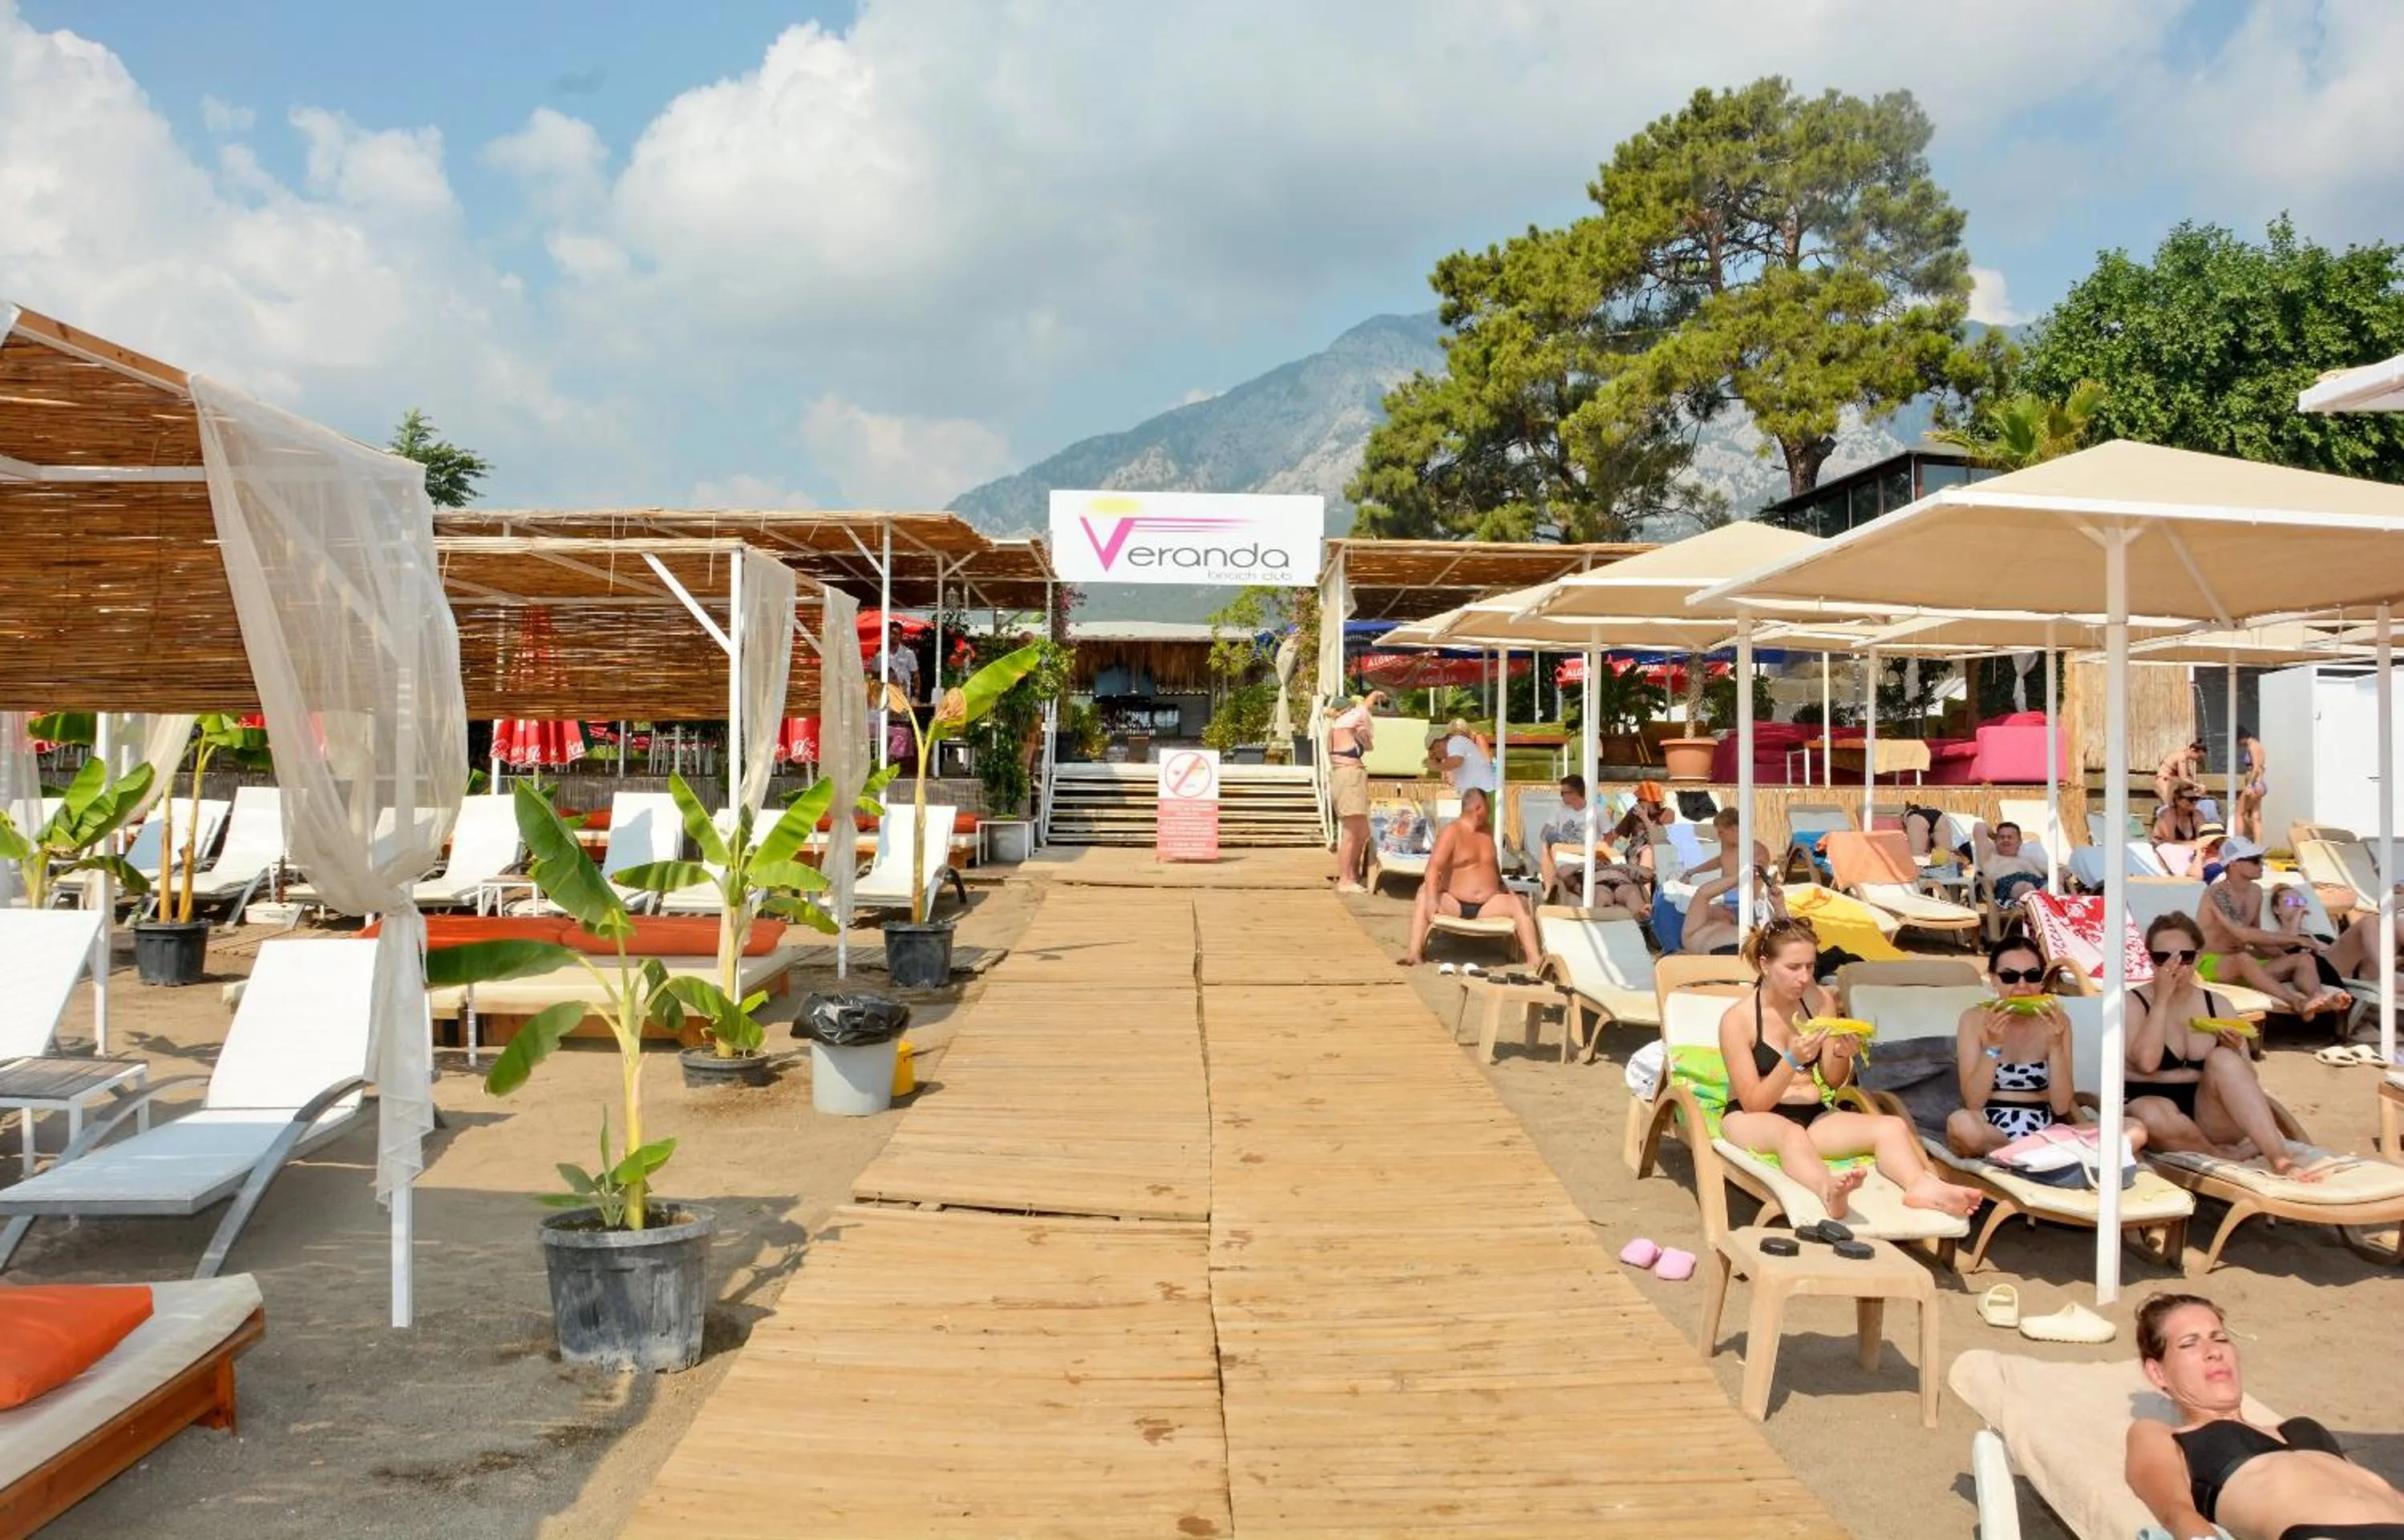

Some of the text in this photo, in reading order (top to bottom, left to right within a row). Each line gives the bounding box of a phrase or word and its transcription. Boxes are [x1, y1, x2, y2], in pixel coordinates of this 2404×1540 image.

[1079, 515, 1289, 572] Veranda
[1207, 569, 1293, 581] beach club
